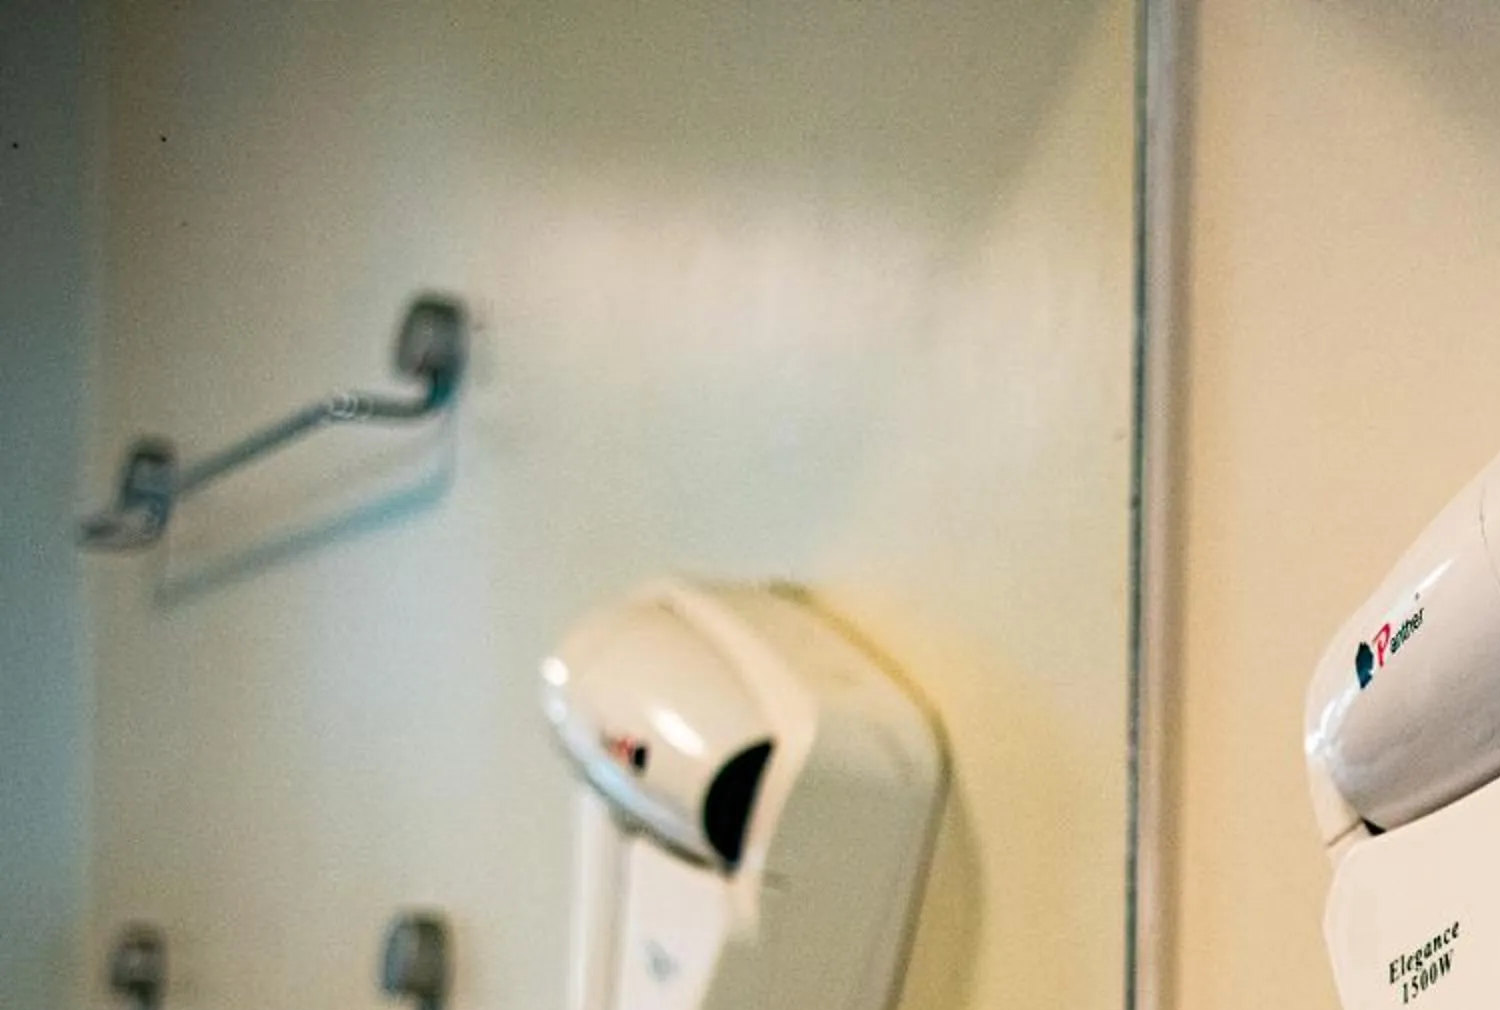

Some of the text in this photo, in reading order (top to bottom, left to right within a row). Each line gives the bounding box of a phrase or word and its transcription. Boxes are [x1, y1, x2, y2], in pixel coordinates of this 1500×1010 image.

[1371, 607, 1425, 668] Panther
[1389, 920, 1460, 985] Elegance
[1403, 948, 1455, 1005] 1500W
